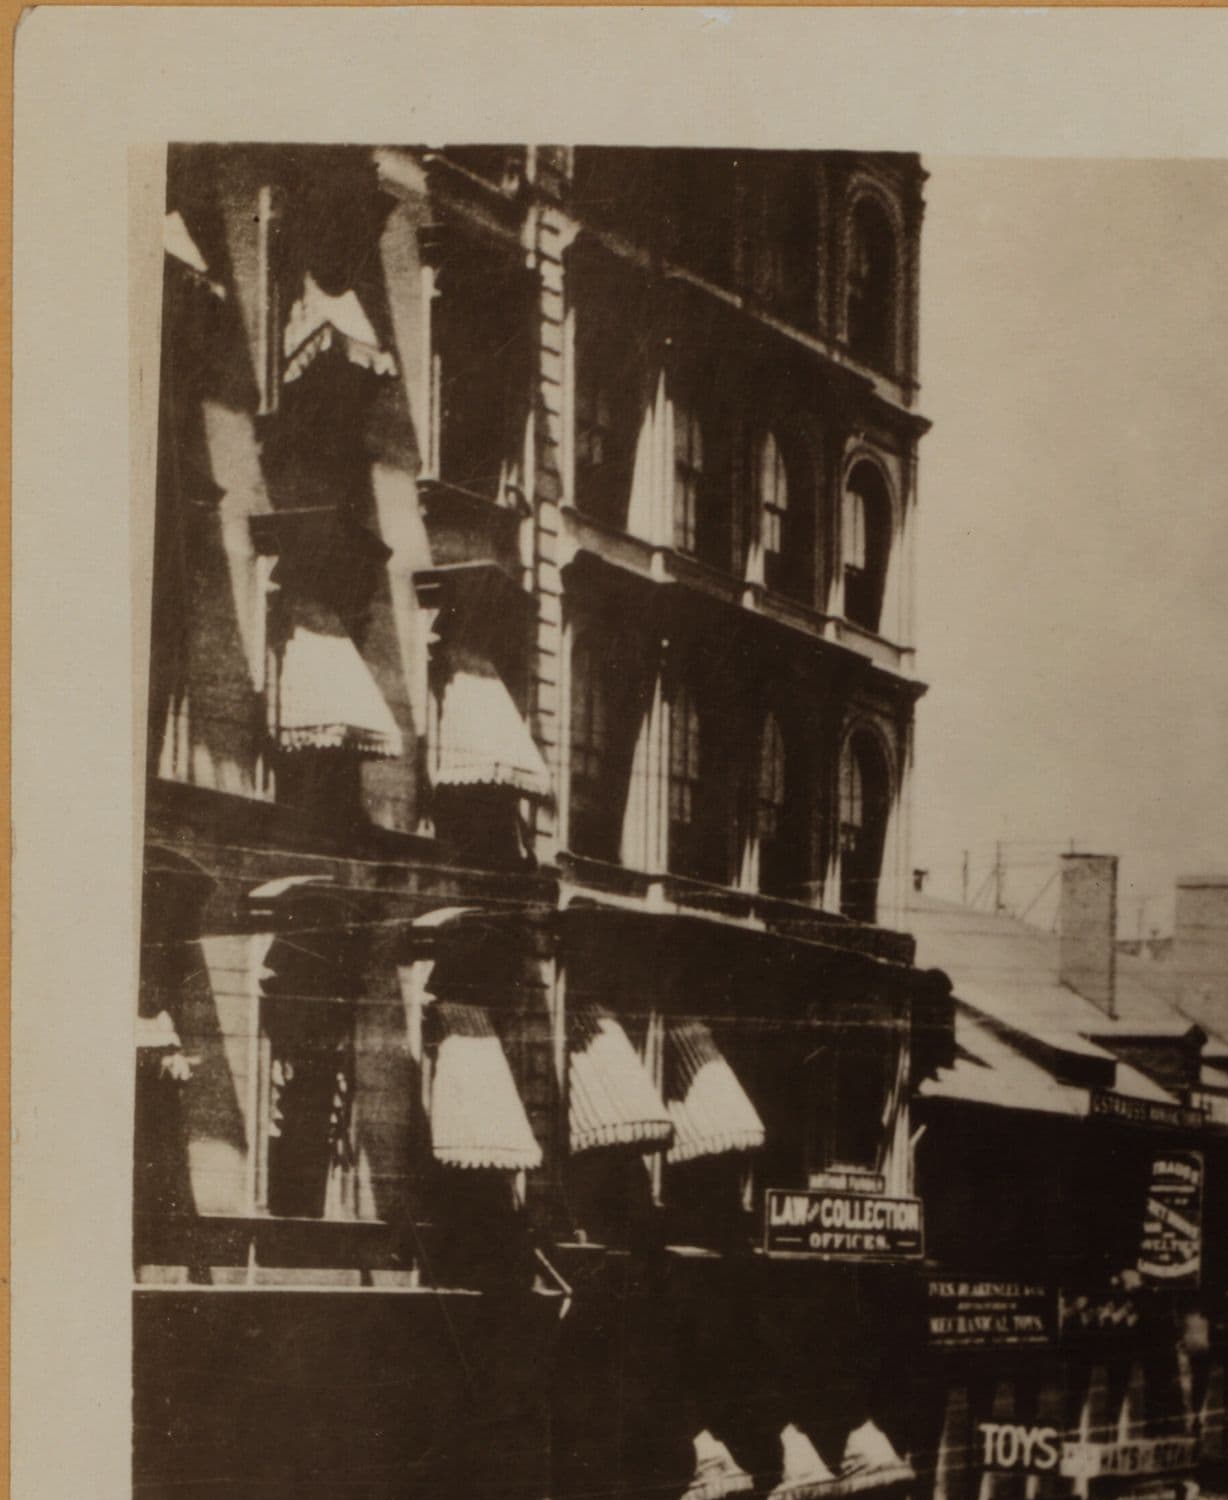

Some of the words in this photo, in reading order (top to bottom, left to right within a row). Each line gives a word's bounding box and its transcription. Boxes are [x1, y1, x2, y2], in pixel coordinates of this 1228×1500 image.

[770, 1195, 809, 1227] LAW
[820, 1198, 920, 1233] COLLECTION
[979, 1423, 1058, 1470] TOYS
